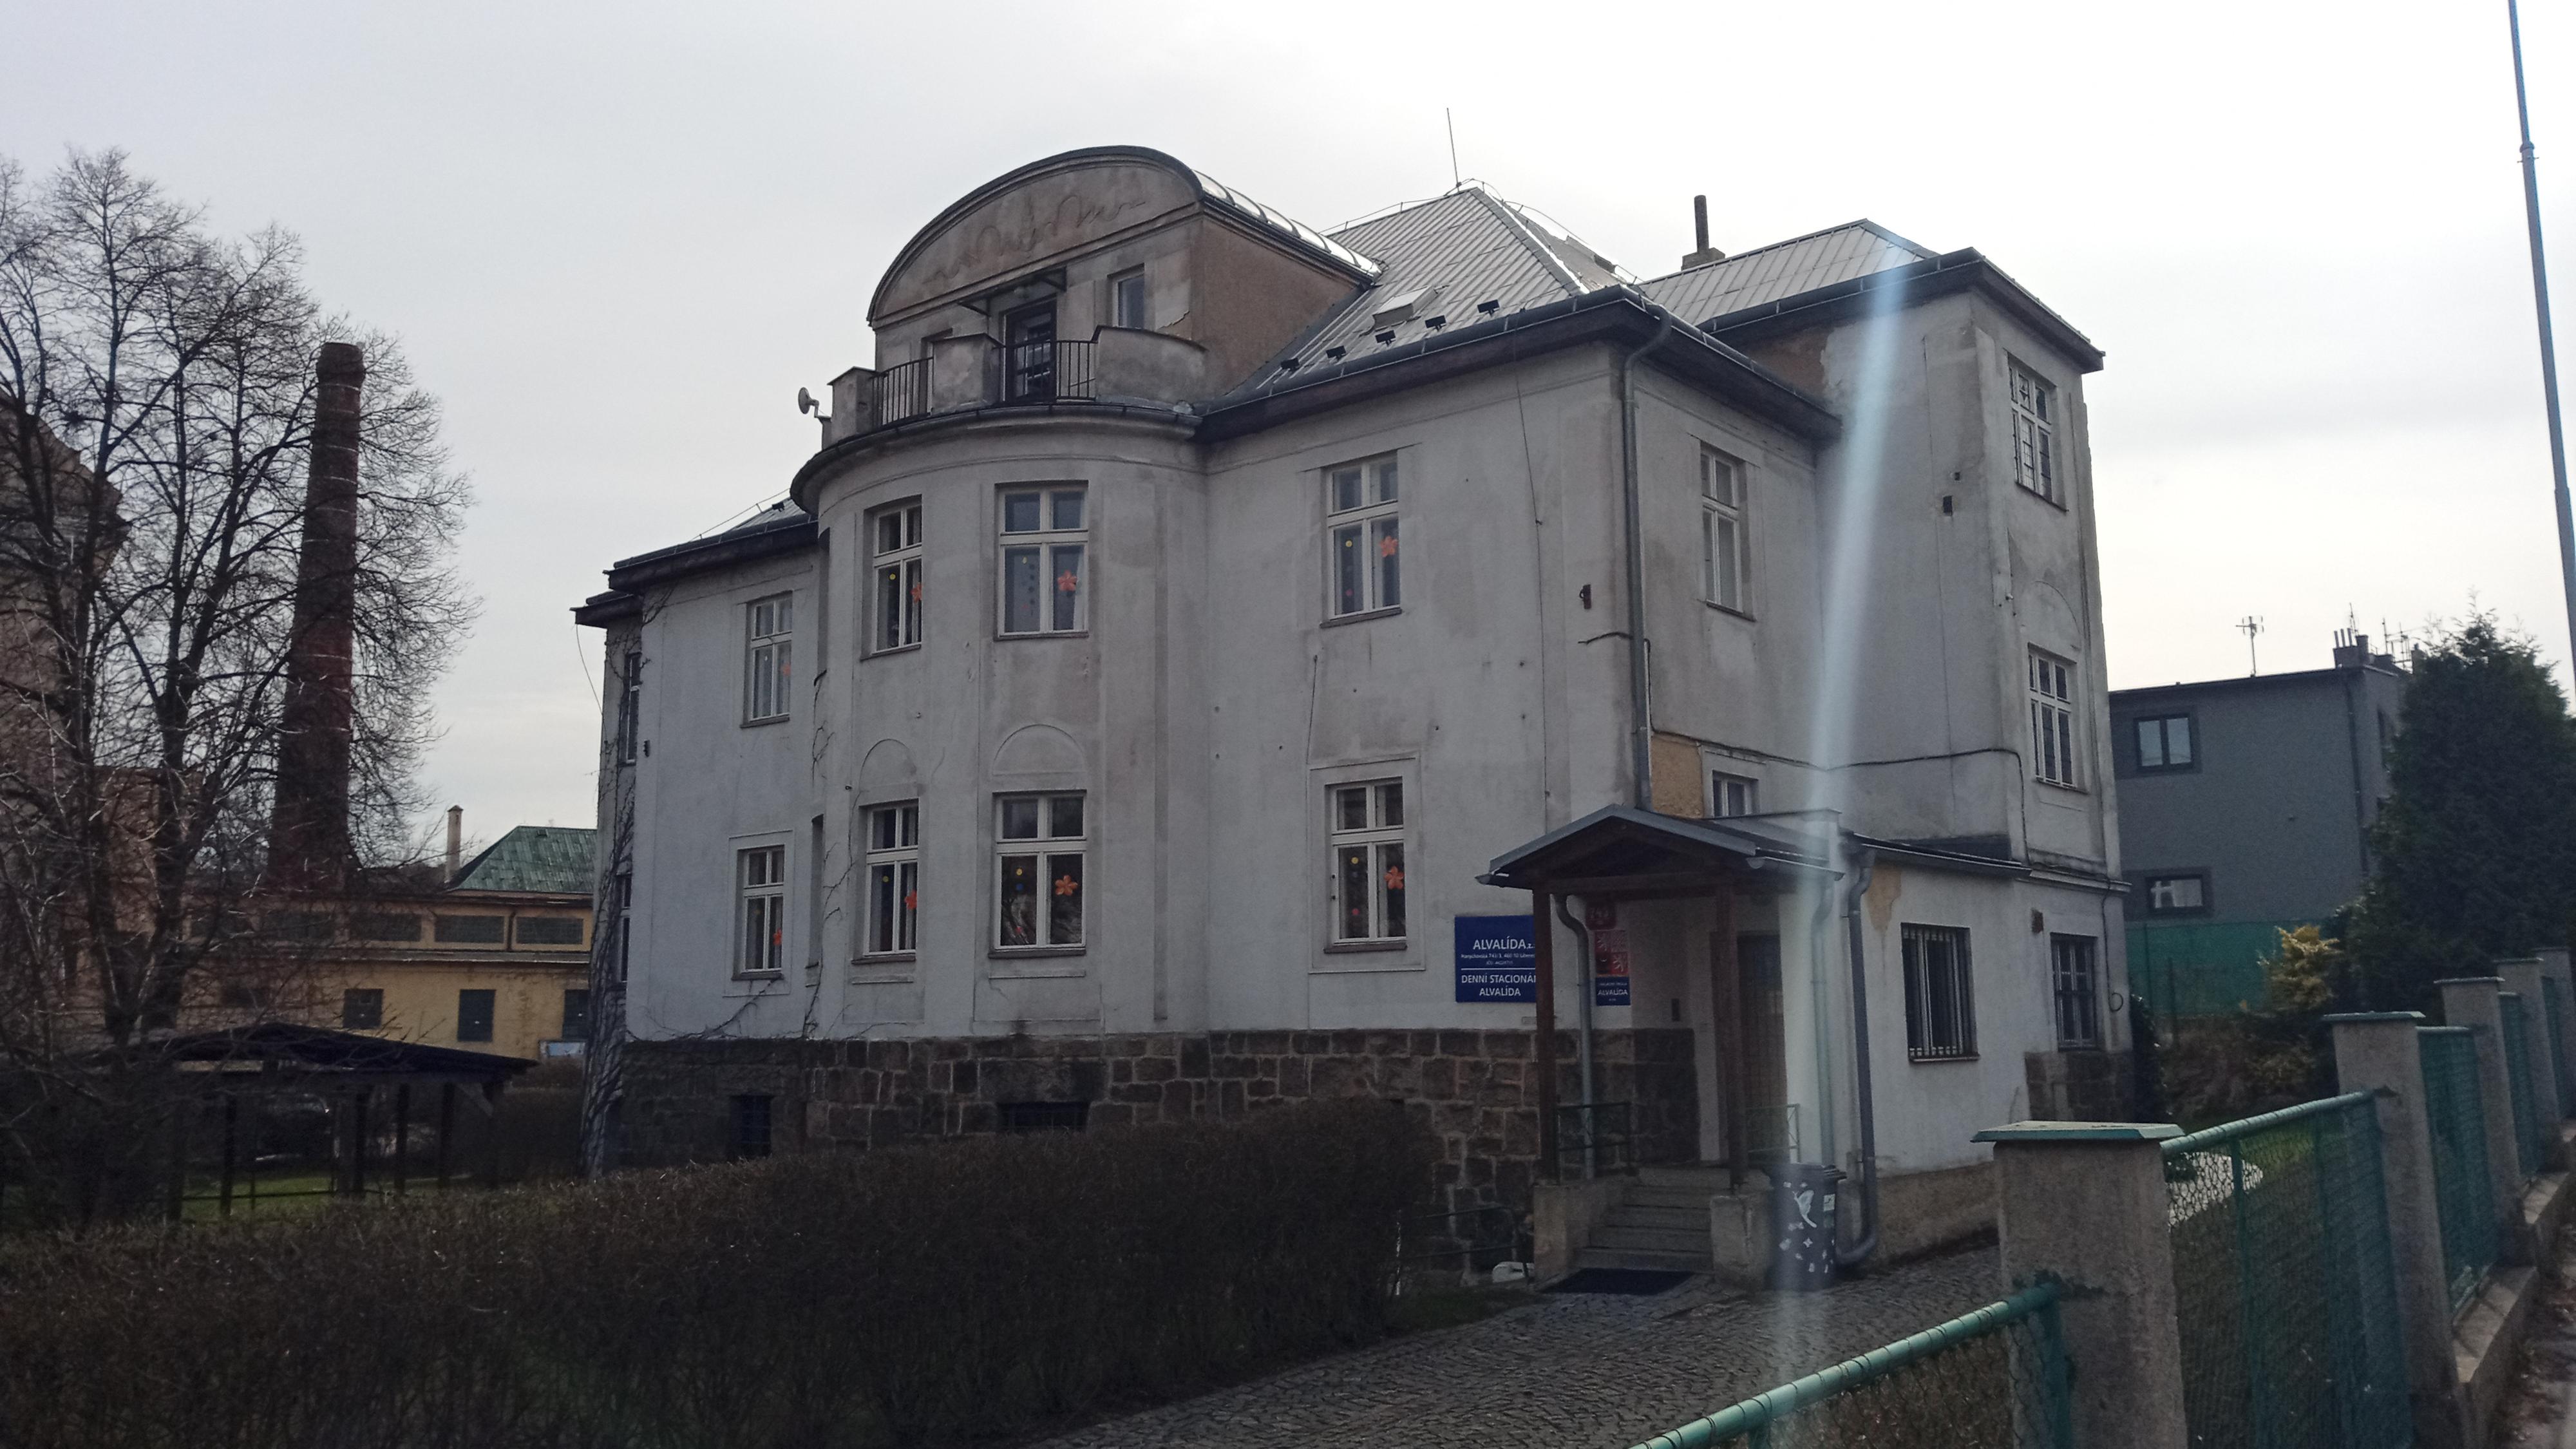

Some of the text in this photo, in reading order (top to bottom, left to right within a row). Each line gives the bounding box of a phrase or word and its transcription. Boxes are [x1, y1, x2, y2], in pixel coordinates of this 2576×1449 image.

[1461, 973, 1488, 983] DENNÍ
[1479, 985, 1521, 996] ALVALÍDA
[1597, 987, 1629, 996] ALVALÍDA
